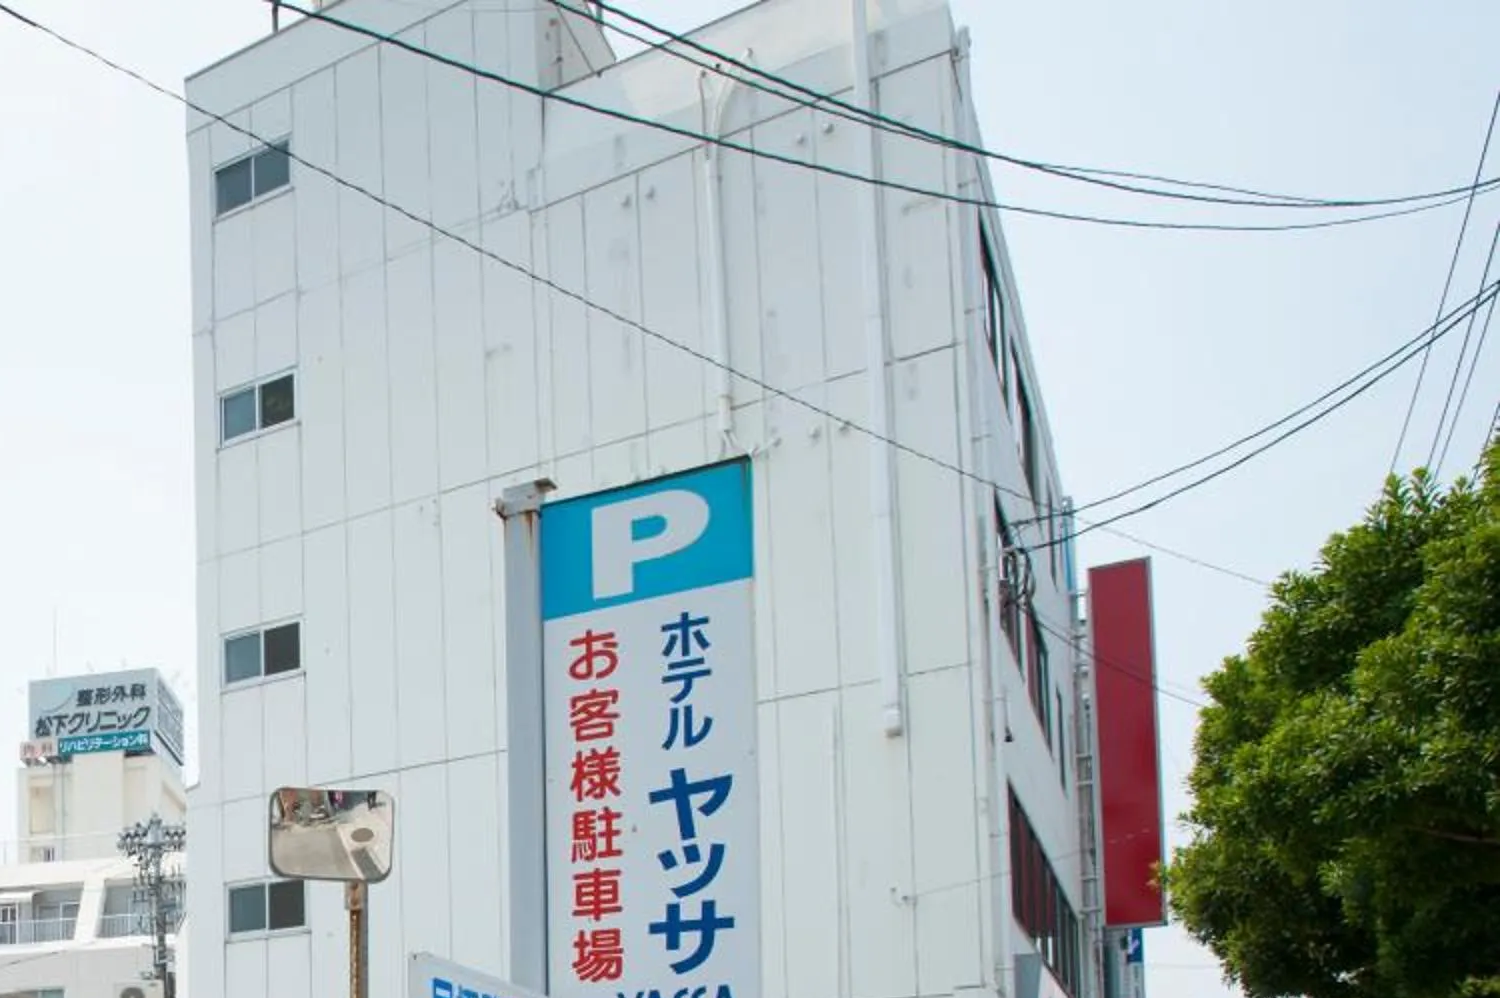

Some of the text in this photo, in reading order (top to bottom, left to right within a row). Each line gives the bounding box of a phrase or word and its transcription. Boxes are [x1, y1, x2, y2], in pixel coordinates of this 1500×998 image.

[591, 489, 710, 602] P
[35, 706, 150, 737] 松下クリニック
[661, 611, 713, 751] ホテル
[568, 629, 625, 984] お客様駐車場
